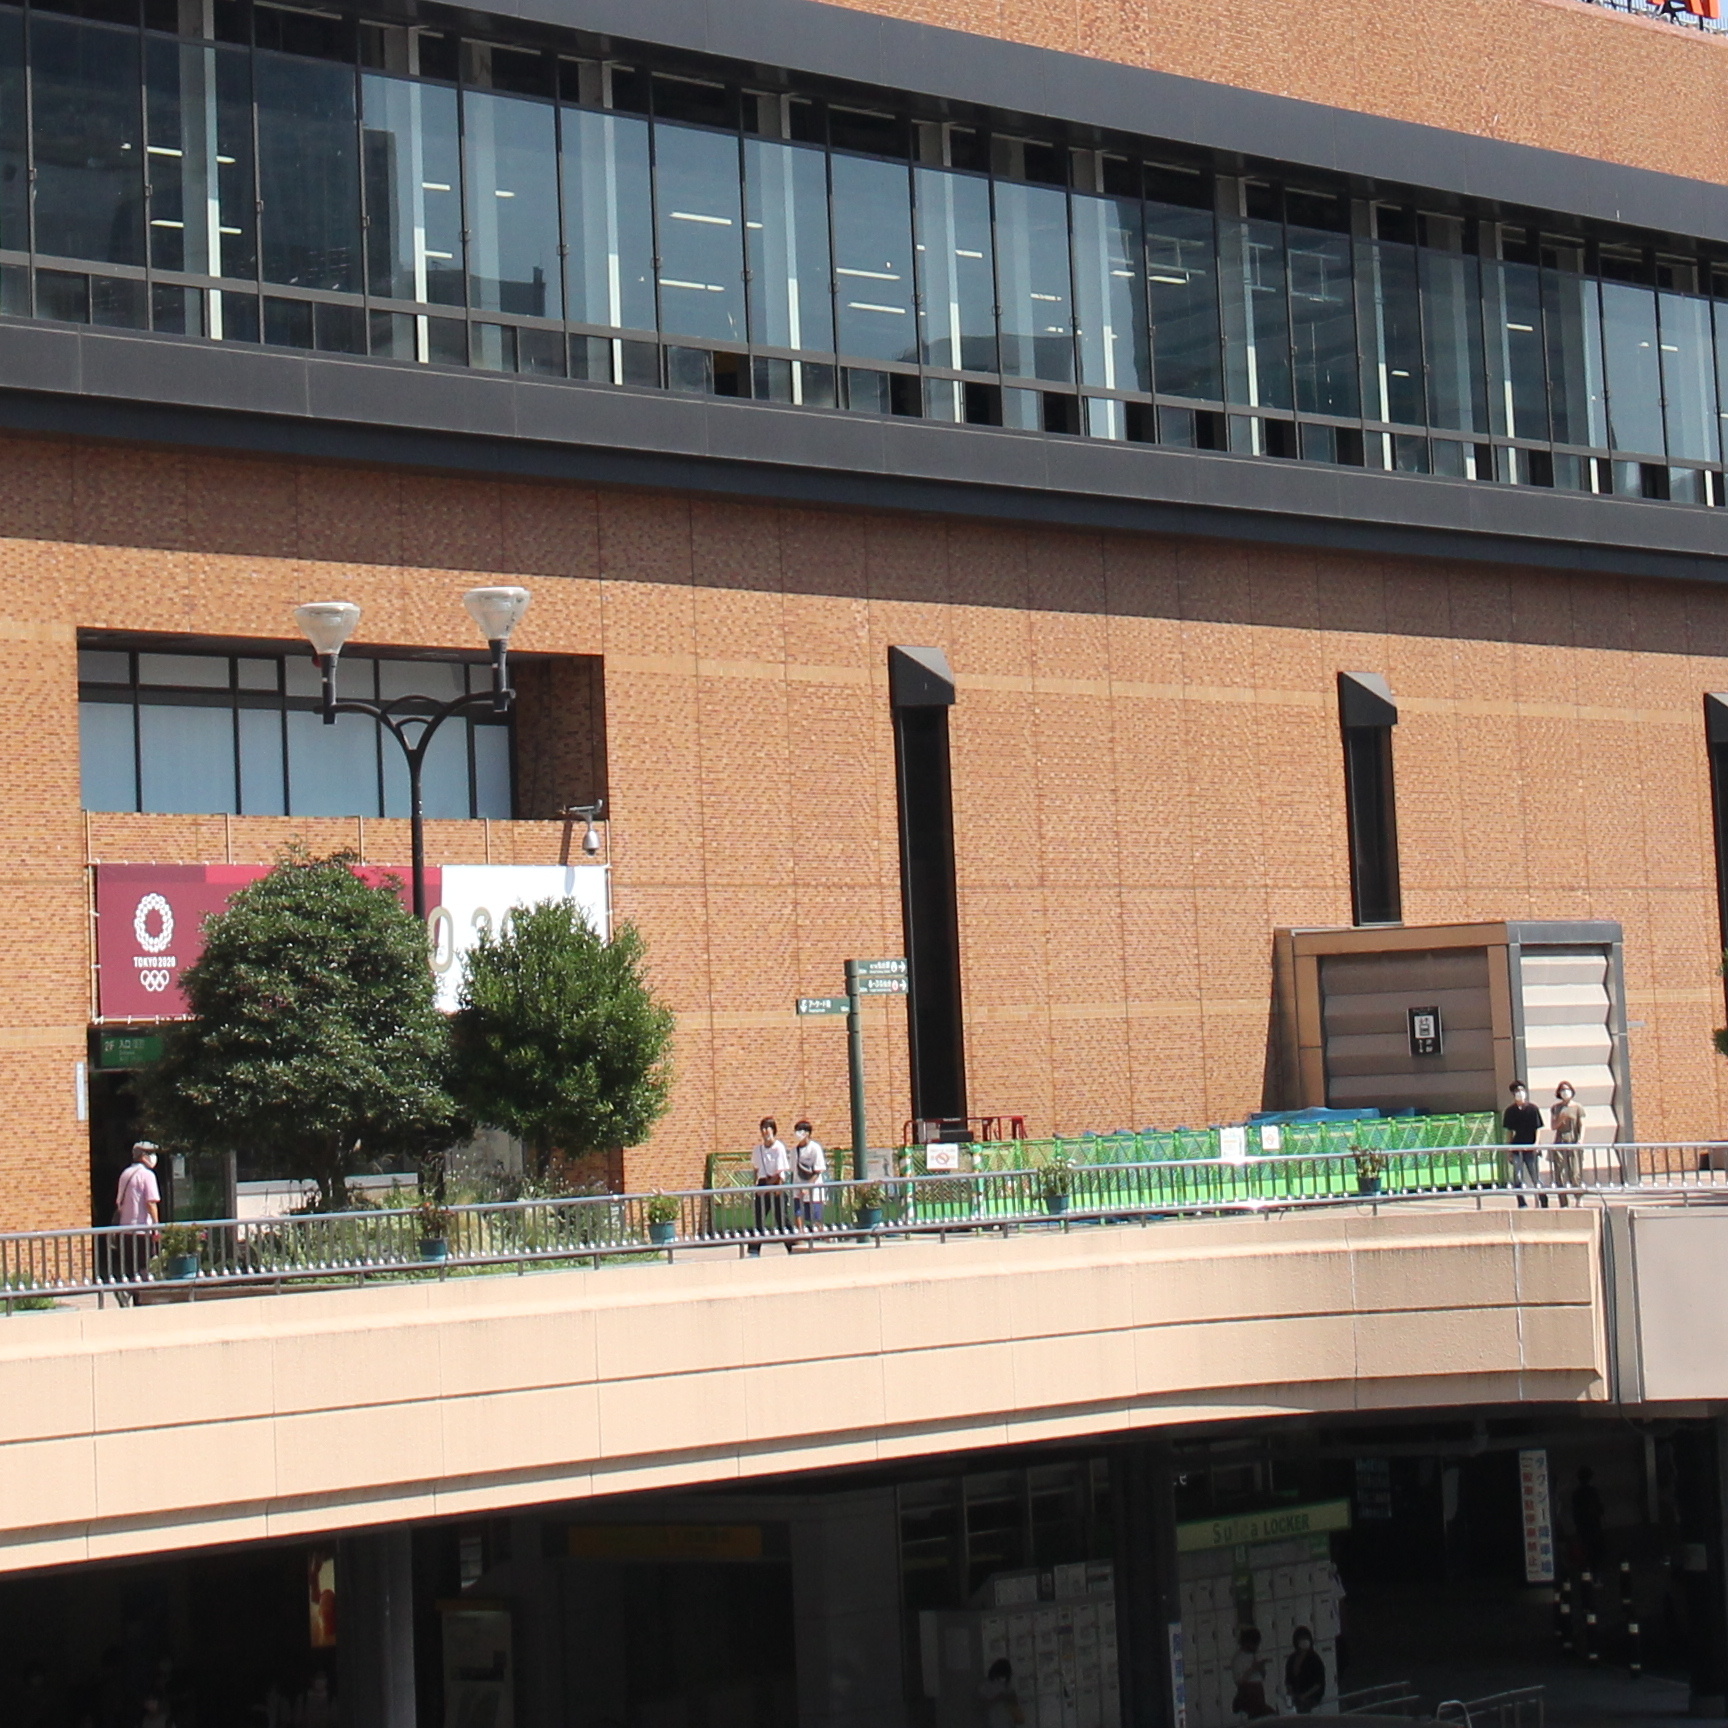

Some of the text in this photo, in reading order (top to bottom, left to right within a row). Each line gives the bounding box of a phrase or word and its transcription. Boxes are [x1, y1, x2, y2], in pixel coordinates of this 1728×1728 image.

[133, 956, 177, 969] TOKYO 2020
[1263, 1513, 1310, 1537] LOCKER
